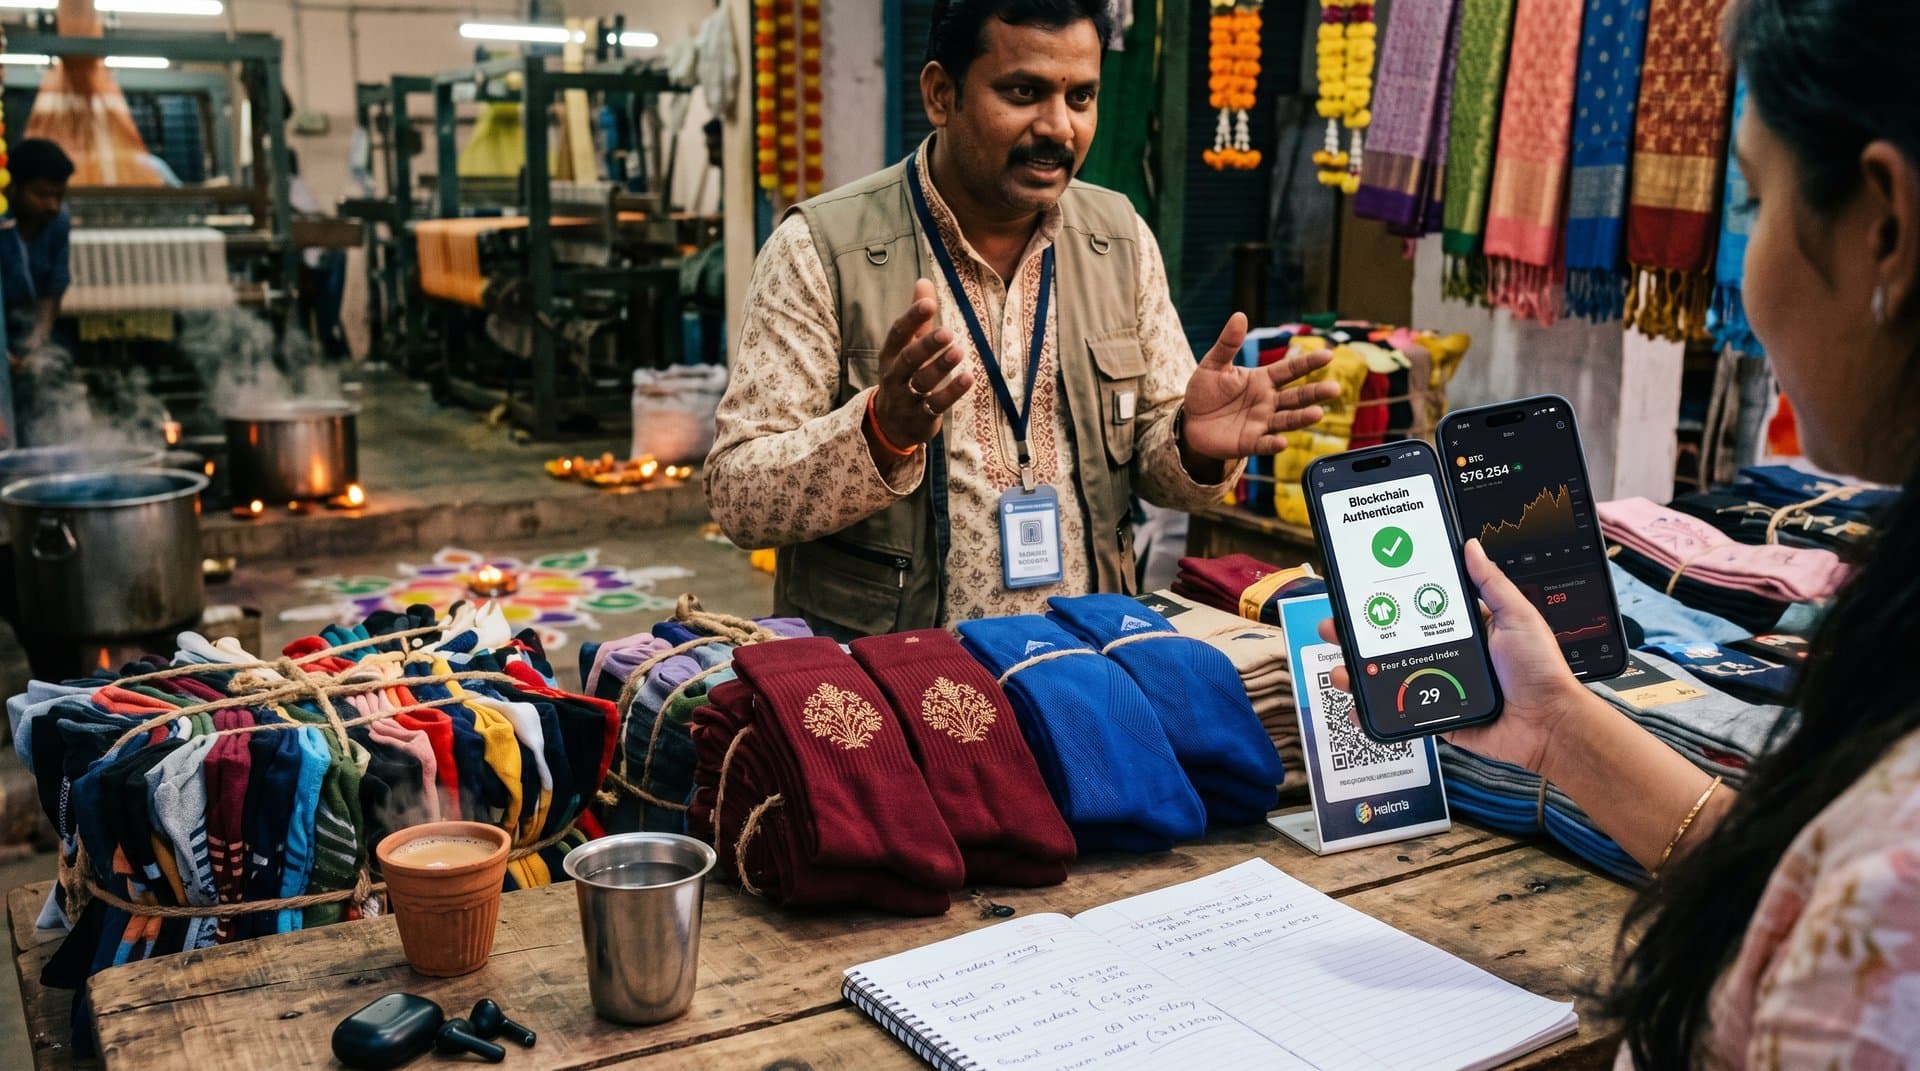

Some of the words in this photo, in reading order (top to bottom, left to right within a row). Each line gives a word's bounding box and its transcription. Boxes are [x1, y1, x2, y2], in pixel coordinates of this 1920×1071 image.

[1468, 454, 1485, 464] BTC
[1349, 488, 1410, 508] Blockchain
[1343, 500, 1424, 524] Authentication
[1381, 661, 1400, 671] Fear
[1401, 659, 1408, 668] &
[1408, 653, 1434, 665] Greed
[1435, 649, 1460, 660] Index
[1419, 688, 1441, 705] 29
